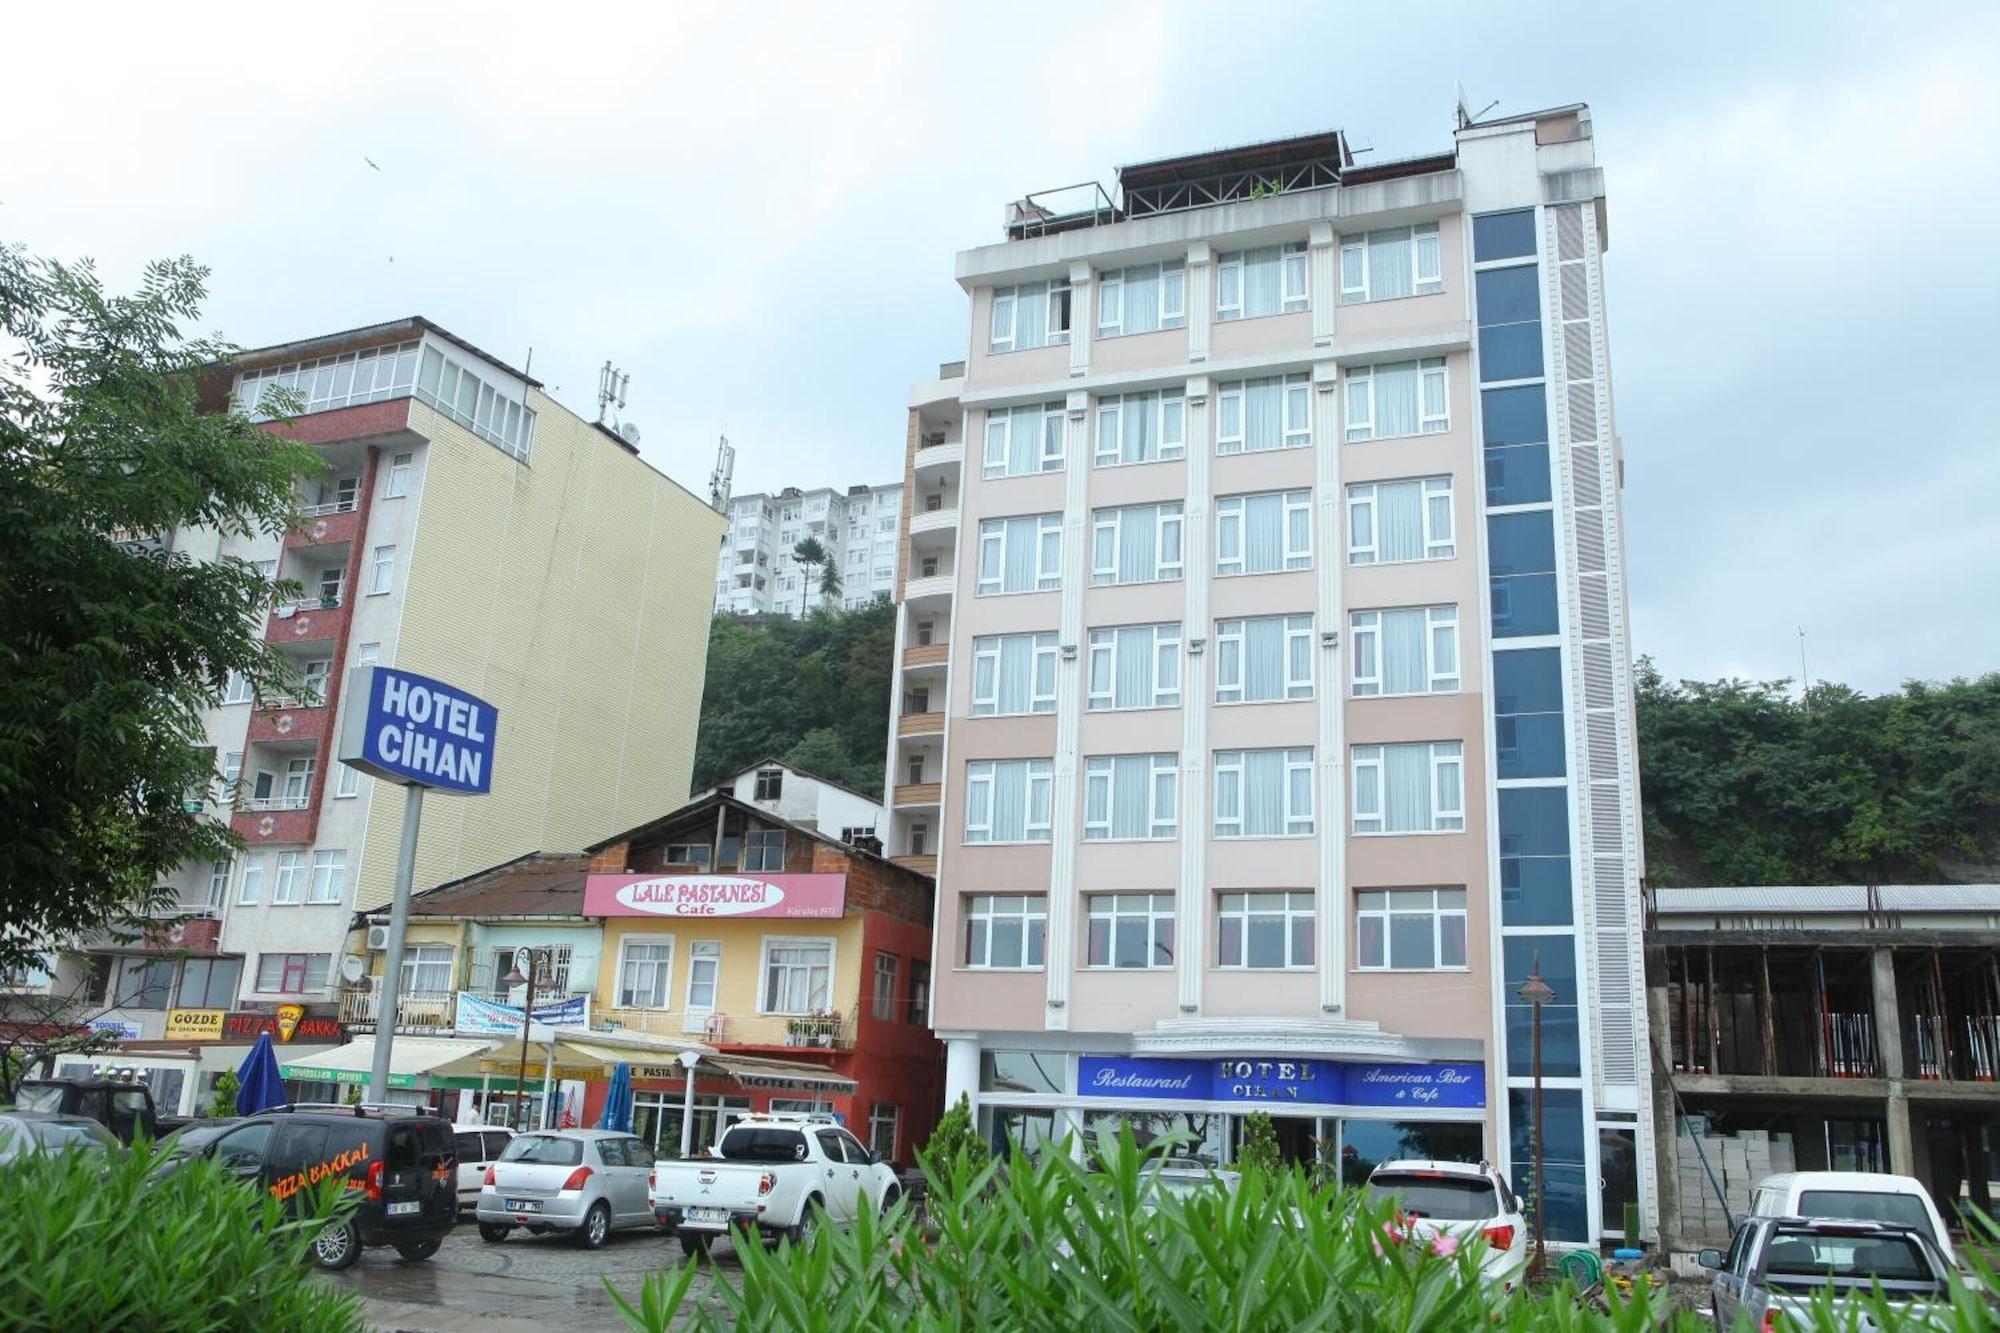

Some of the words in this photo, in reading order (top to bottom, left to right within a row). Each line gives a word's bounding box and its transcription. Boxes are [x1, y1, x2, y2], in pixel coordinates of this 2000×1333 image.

[382, 675, 485, 743] HOTEL
[378, 721, 482, 787] CİHAN
[632, 884, 673, 903] LALE
[678, 881, 768, 904] PASTANESİ
[675, 903, 716, 915] Cafe
[643, 1067, 672, 1077] PASTA
[1092, 1068, 1193, 1089] Restaurant
[1220, 1061, 1315, 1081] HOTEL
[1363, 1068, 1432, 1084] American
[1436, 1068, 1471, 1084] Bar
[742, 1075, 796, 1089] HOTEL
[1395, 1089, 1405, 1099] &
[1411, 1087, 1439, 1103] Cafe
[310, 1142, 369, 1185] BAKKAL
